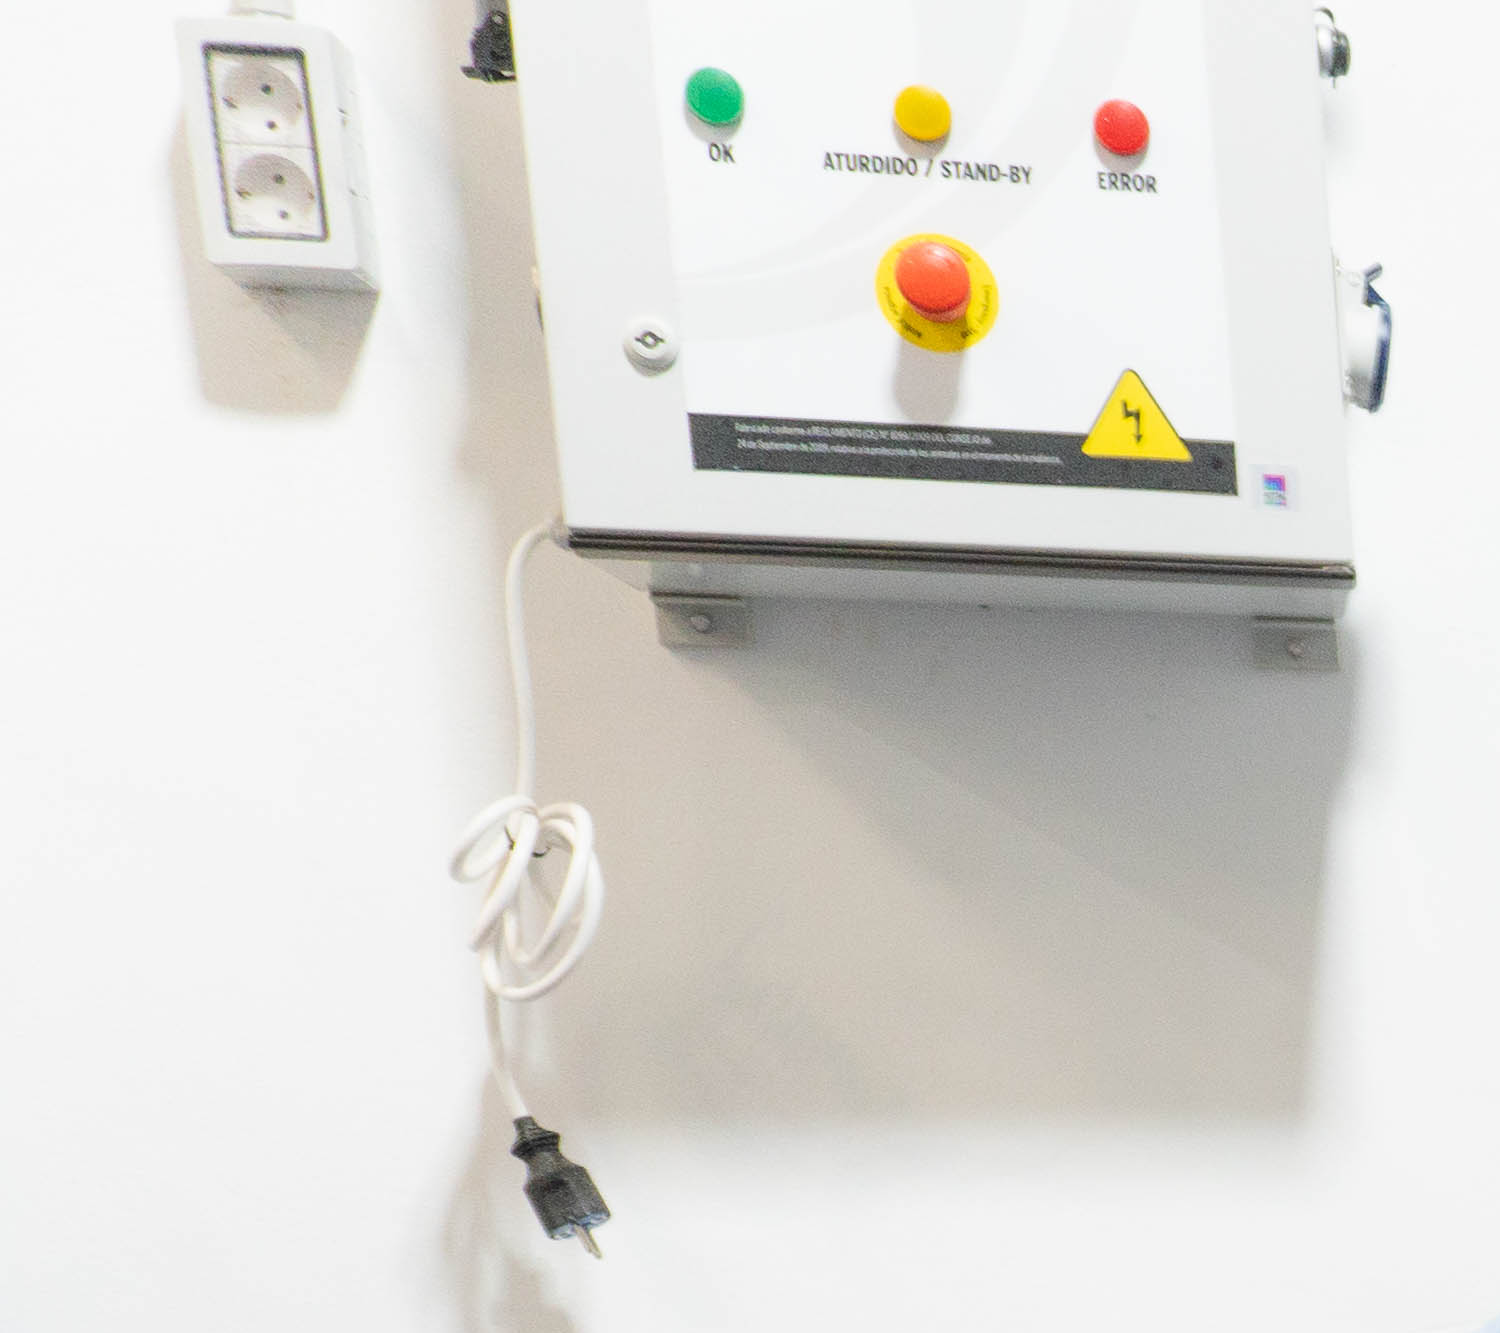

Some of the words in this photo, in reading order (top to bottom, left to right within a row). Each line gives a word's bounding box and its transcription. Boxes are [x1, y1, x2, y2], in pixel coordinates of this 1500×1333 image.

[708, 142, 736, 163] OK
[824, 151, 918, 176] ATURDIDO
[925, 159, 933, 178] /
[941, 160, 1032, 184] STAND-BY
[1098, 172, 1157, 193] ERROR
